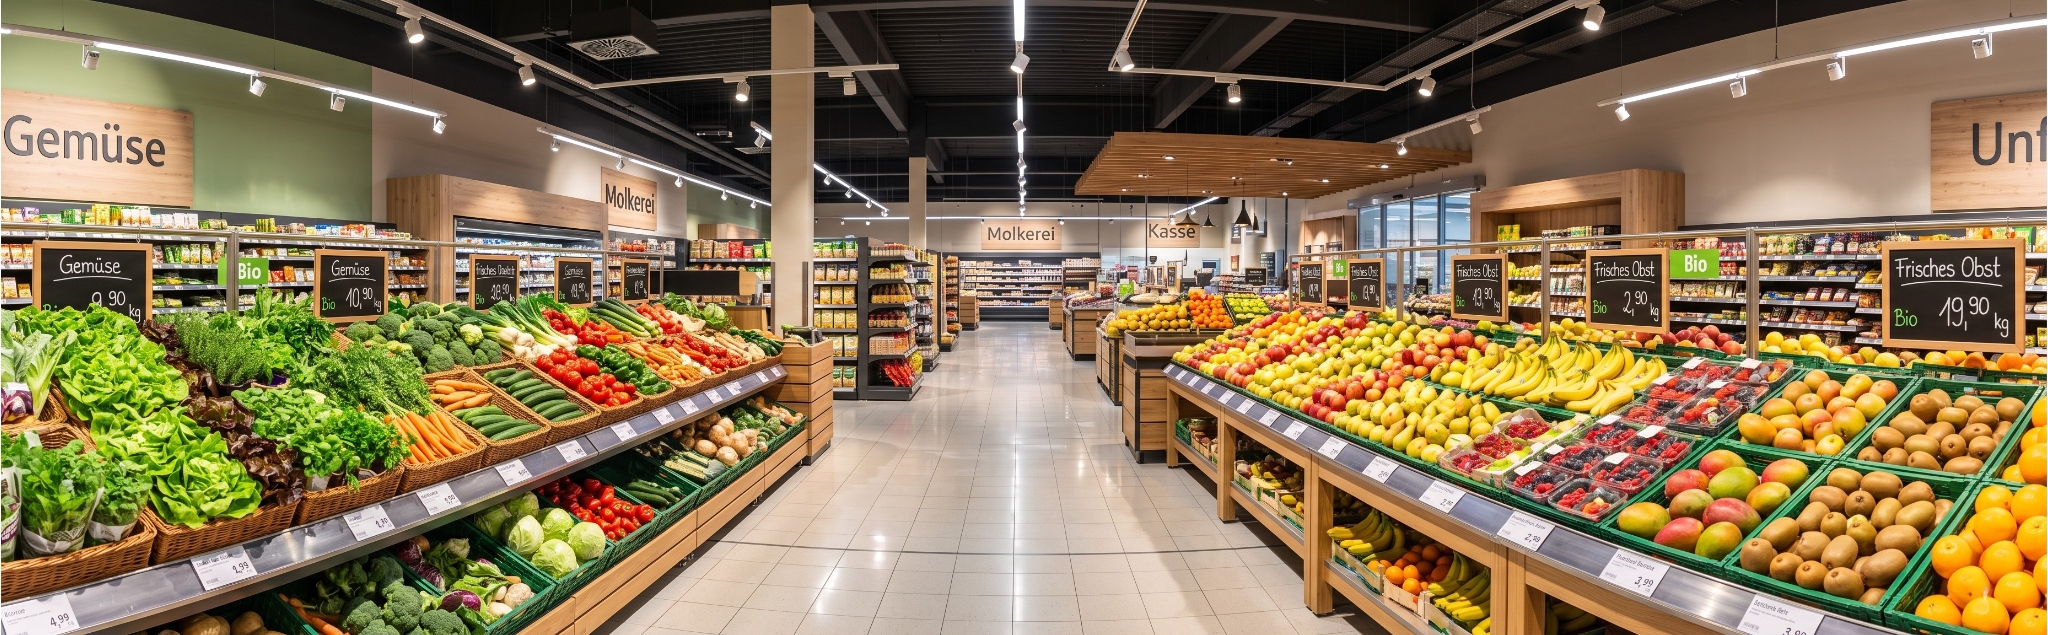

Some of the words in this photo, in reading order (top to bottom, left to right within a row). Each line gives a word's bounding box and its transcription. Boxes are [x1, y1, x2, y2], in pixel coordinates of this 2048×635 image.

[4, 114, 166, 167] Gemüse
[1972, 116, 2047, 166] Unf
[605, 183, 655, 214] Molkerei
[987, 226, 1055, 241] Molkerei
[1149, 223, 1196, 239] Kasse
[59, 254, 121, 274] Gemüse
[238, 262, 261, 280] Bio
[331, 259, 371, 277] Gemüse
[1594, 261, 1629, 277] Frisches
[1632, 260, 1655, 277] Obst
[1684, 254, 1707, 273] Bio
[1894, 257, 1955, 278] Frisches
[1961, 256, 2001, 278] Obst
[322, 296, 336, 311] Bio
[345, 287, 374, 310] 10,90
[373, 298, 382, 313] kg
[1455, 294, 1466, 308] Bio
[1472, 287, 1493, 310] 13,90
[1493, 297, 1501, 314] kg
[1592, 299, 1608, 315] Bio
[1622, 290, 1648, 317] 2,90
[1650, 302, 1660, 322] kg
[129, 304, 141, 324] kg
[1893, 308, 1918, 327] Bio
[1938, 296, 1990, 332] 19,90
[1994, 312, 2009, 338] kg
[50, 612, 70, 629] 4,99
